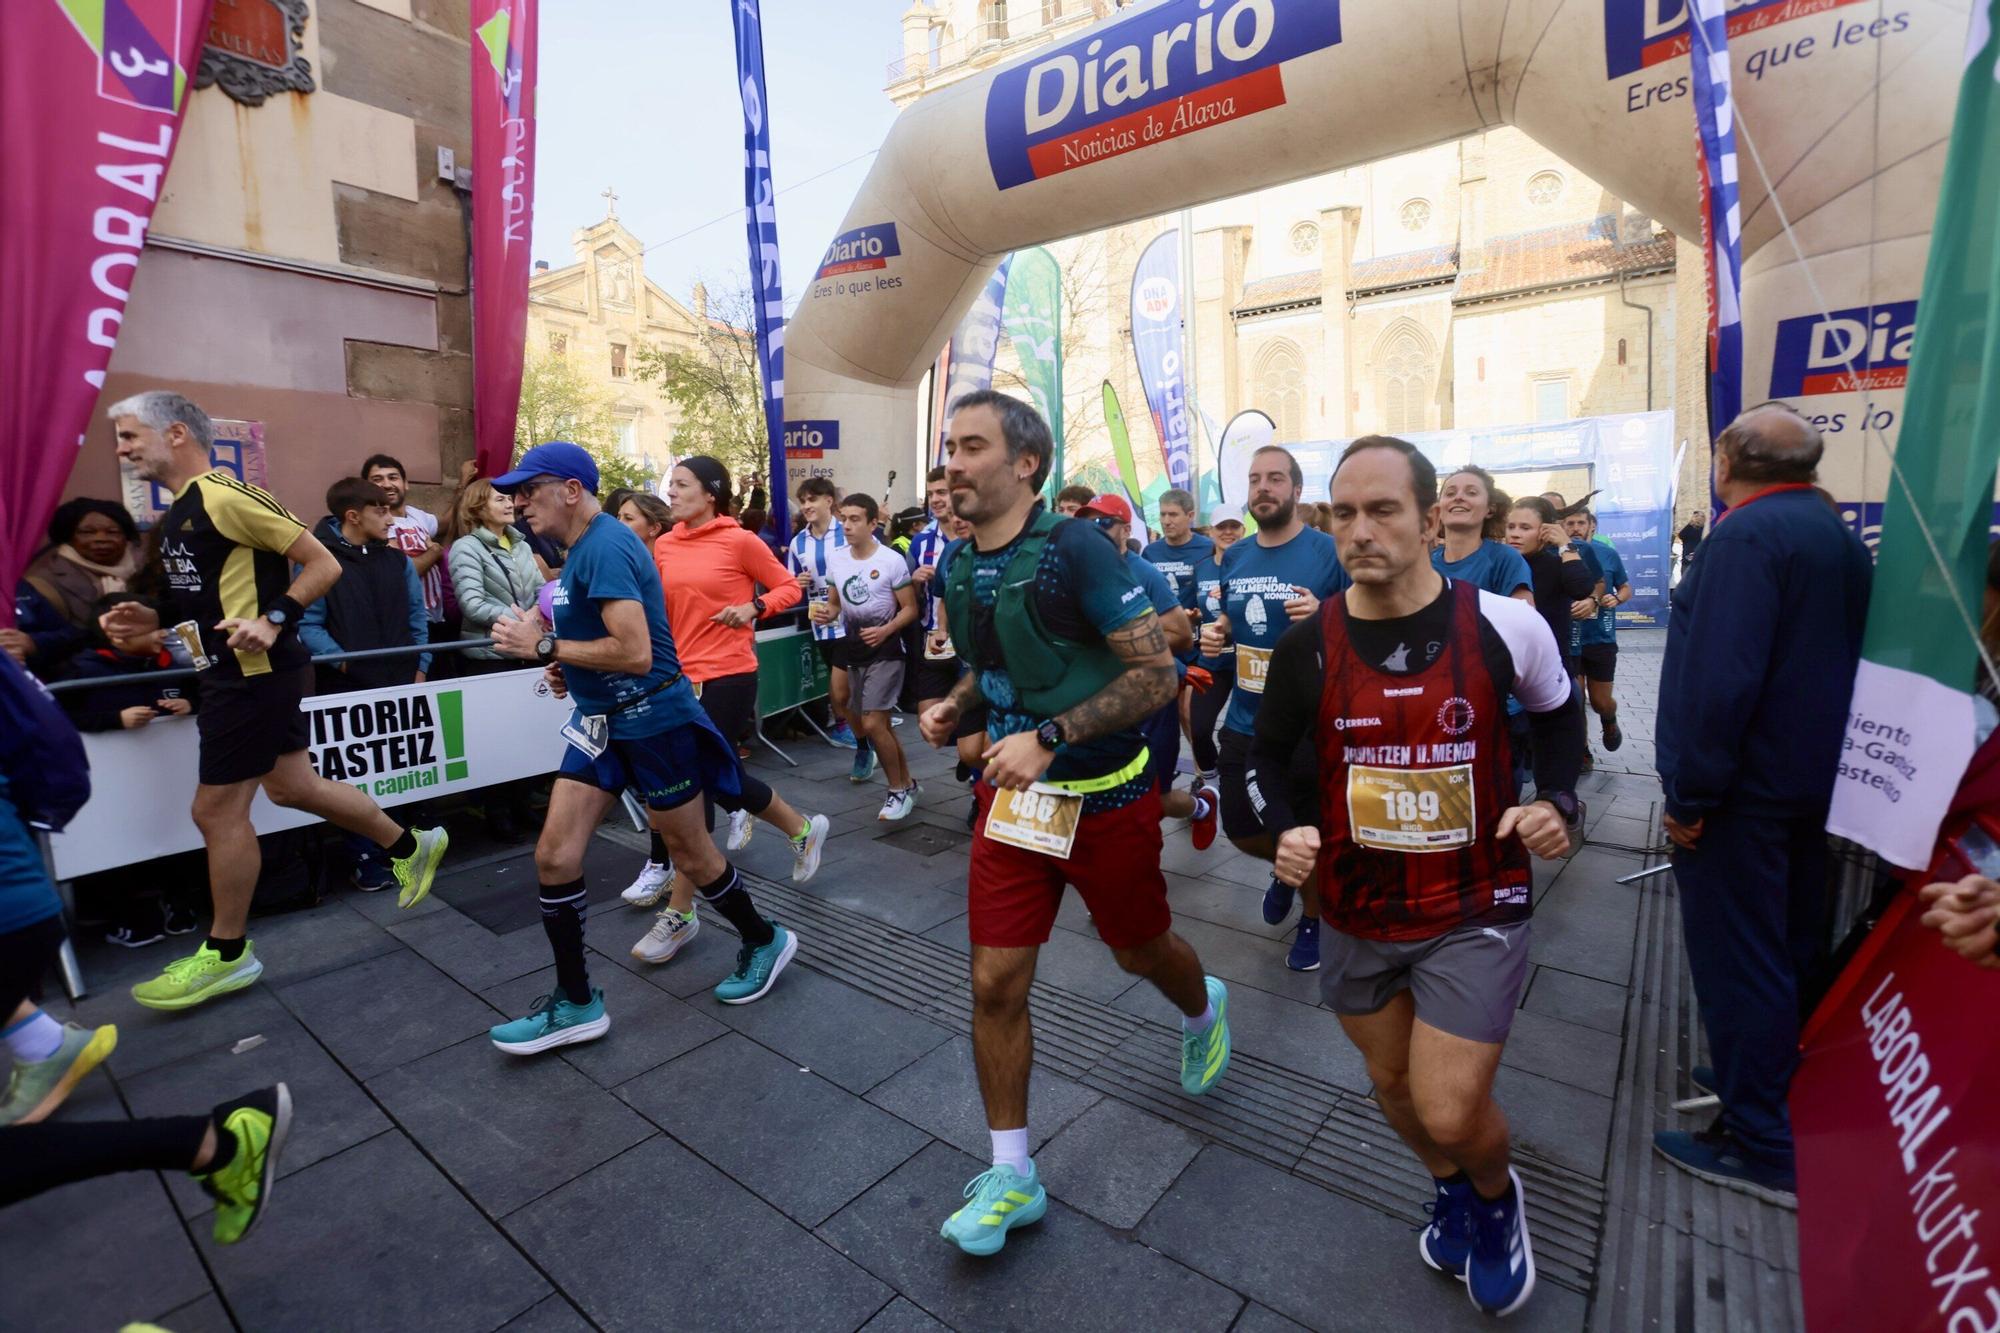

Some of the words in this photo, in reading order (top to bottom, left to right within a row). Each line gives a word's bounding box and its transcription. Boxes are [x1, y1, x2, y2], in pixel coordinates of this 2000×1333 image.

[1745, 36, 1815, 81] que
[1832, 11, 1909, 48] lees
[1025, 0, 1275, 136] Diario
[1627, 76, 1688, 113] Eres
[1062, 127, 1136, 166] Noticias
[1142, 116, 1164, 141] de
[1170, 96, 1236, 133] Álava
[823, 231, 884, 267] Diario
[814, 284, 832, 299] Eres
[836, 281, 845, 295] lo
[848, 280, 872, 297] que
[875, 276, 902, 291] lees
[1806, 311, 1917, 370] Dia
[1156, 350, 1190, 483] Diario
[784, 424, 823, 447] ario
[810, 464, 834, 478] lees
[1235, 583, 1294, 594] ALMENDRA
[374, 766, 439, 797] capital
[1380, 790, 1440, 822] 189
[1861, 971, 1951, 1175] LABORAL
